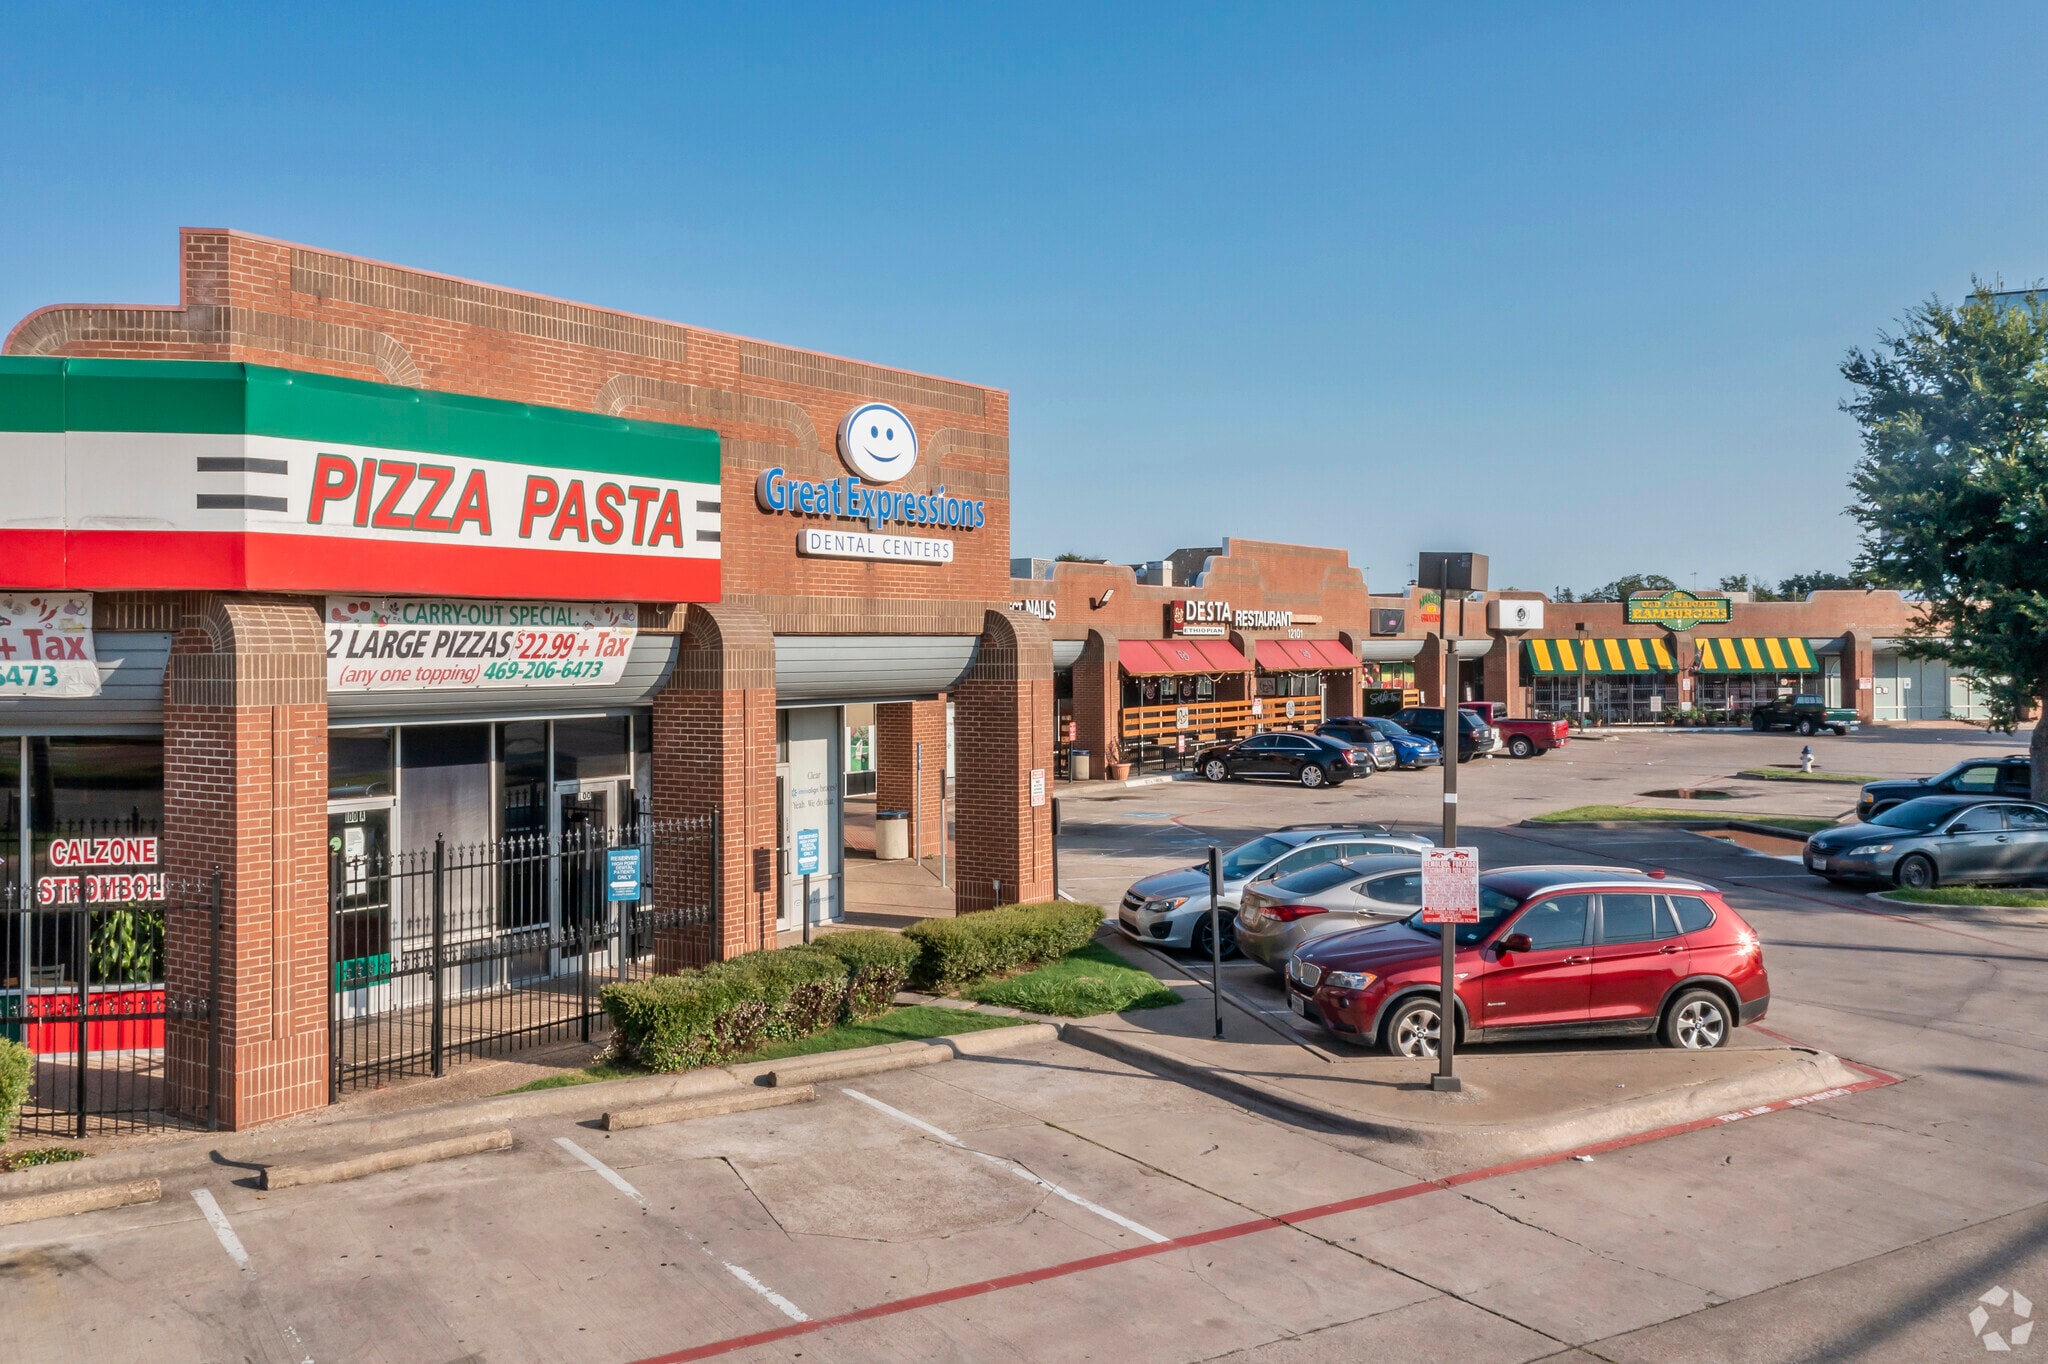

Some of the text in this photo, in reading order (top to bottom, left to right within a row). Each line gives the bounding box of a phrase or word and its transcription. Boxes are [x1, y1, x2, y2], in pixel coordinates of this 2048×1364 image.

[307, 452, 685, 549] PIZZA PASTA
[765, 466, 986, 530] Great Expressions
[811, 533, 950, 558] DENTAL CENTERS
[402, 602, 580, 627] CARRY-OUT SPECIAL:
[1025, 600, 1056, 620] NAILS
[1186, 600, 1293, 627] DESTA RESTAURANT
[1632, 608, 1728, 619] HAMBURGERS
[327, 629, 630, 659] 2 LARGE PIZZAS $22.99 + Tax
[1184, 627, 1223, 635] ETHIOPIAN
[1287, 629, 1304, 639] 12101
[22, 629, 88, 661] Tax
[339, 660, 604, 687] (any one topping) 469-206-6473
[50, 837, 158, 867] CALZONE
